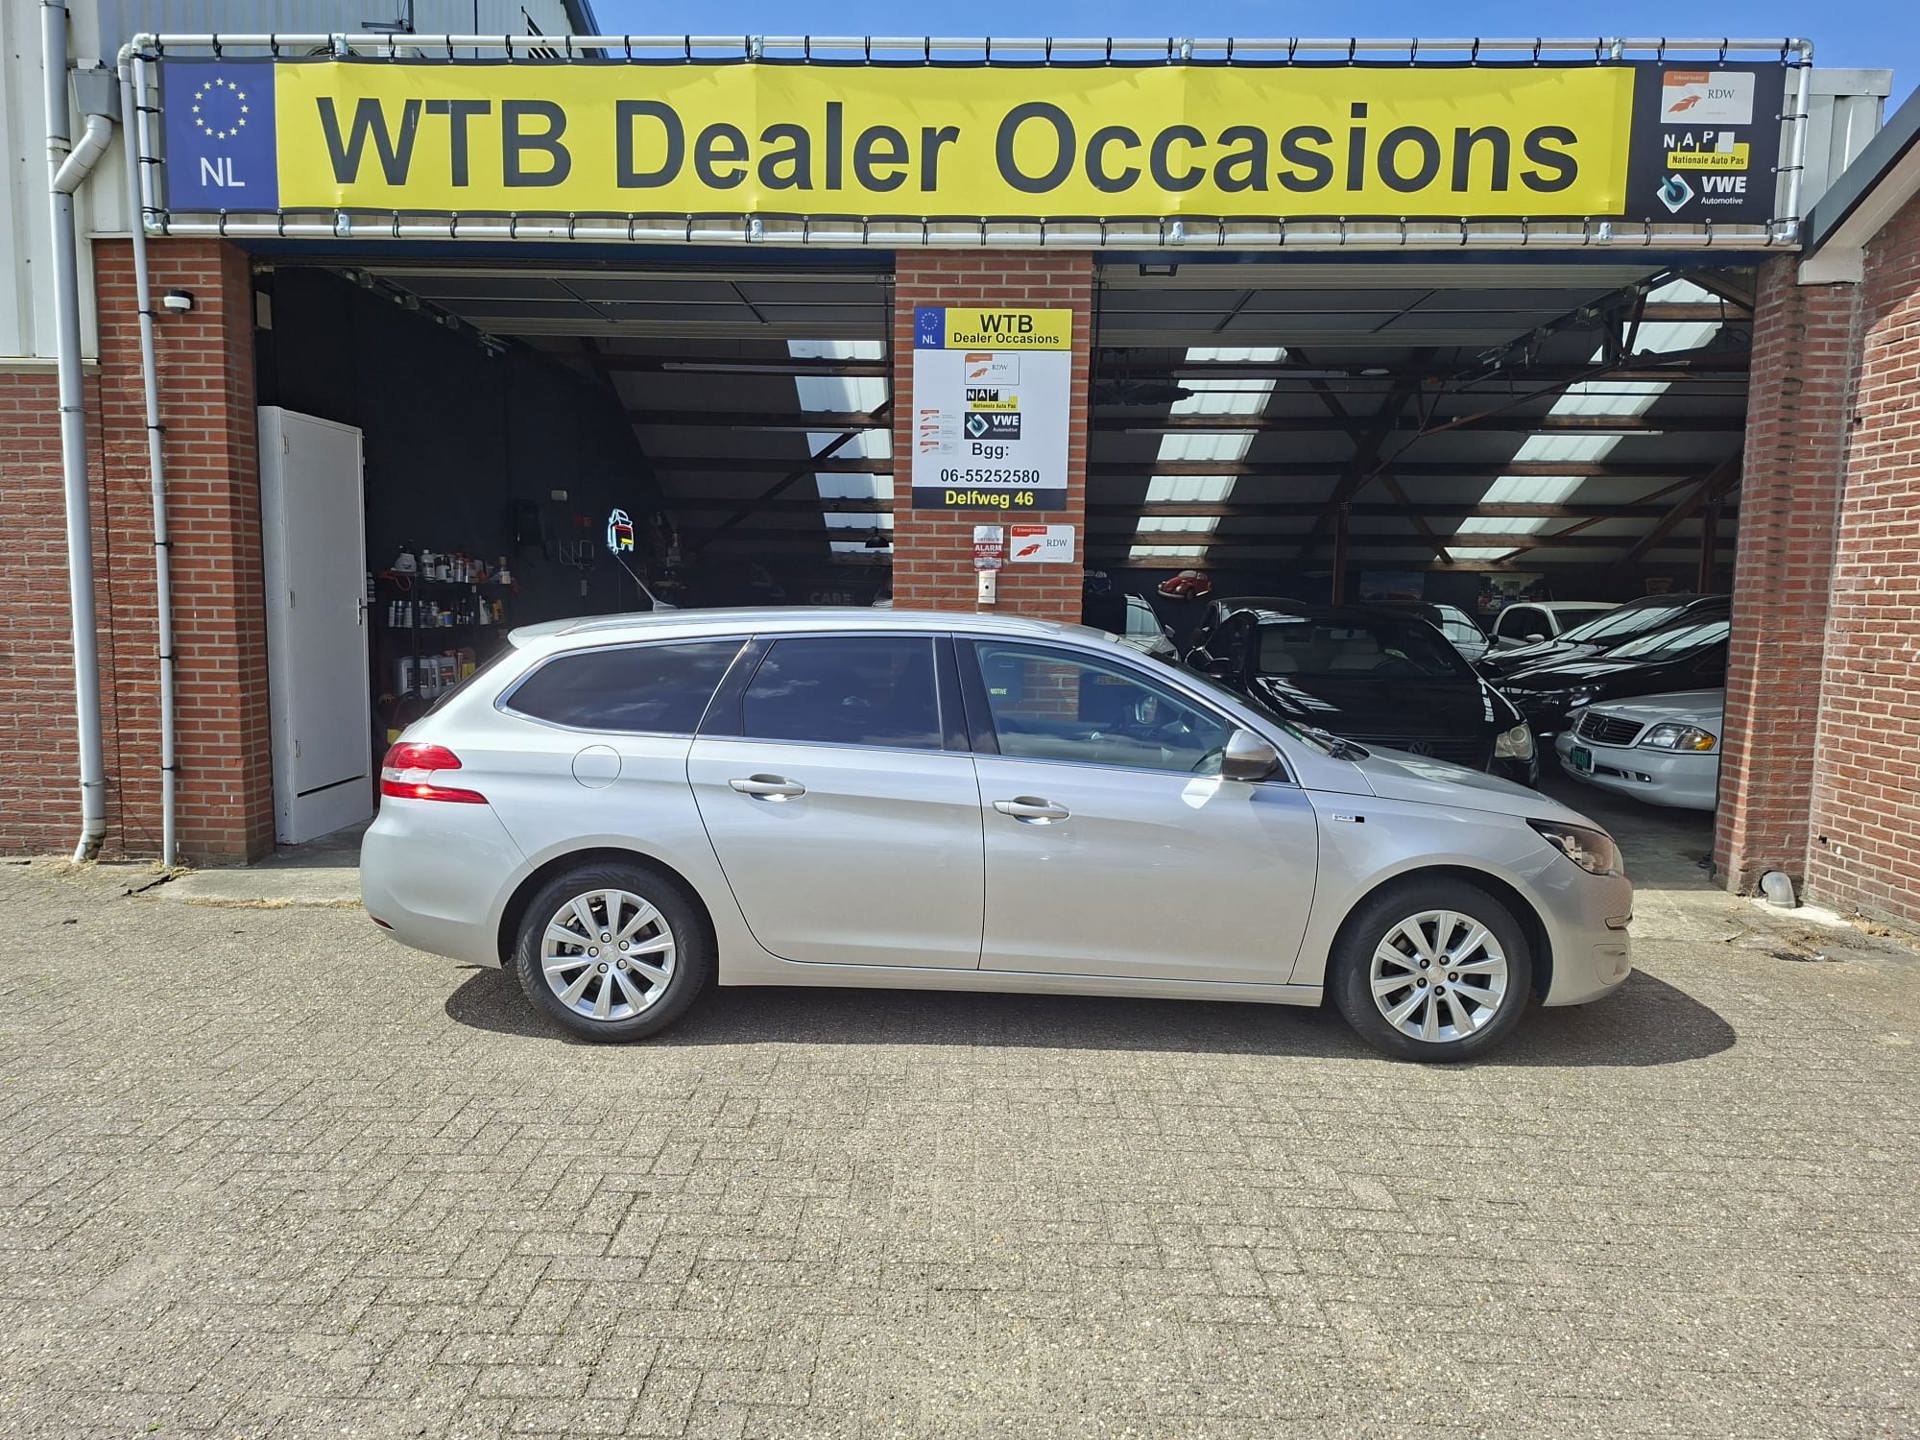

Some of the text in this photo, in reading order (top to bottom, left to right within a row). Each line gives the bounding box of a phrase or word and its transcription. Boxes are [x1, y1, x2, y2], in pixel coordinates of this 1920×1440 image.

[1708, 89, 1734, 99] RDW
[316, 96, 1580, 194] WTB Dealer Occasions
[1672, 155, 1745, 166] Nationale Auto Pas
[200, 156, 246, 187] NL
[1701, 176, 1747, 193] VWE
[1700, 197, 1744, 205] Automotive
[980, 314, 1033, 333] WTB
[922, 335, 936, 344] NL
[953, 333, 1060, 345] Dealer Occasions
[992, 415, 1019, 425] VWE
[972, 442, 1009, 459] Bgg:
[940, 469, 1040, 483] 06-55252580
[945, 491, 1034, 508] Delfweg 46
[1046, 539, 1068, 547] RDW
